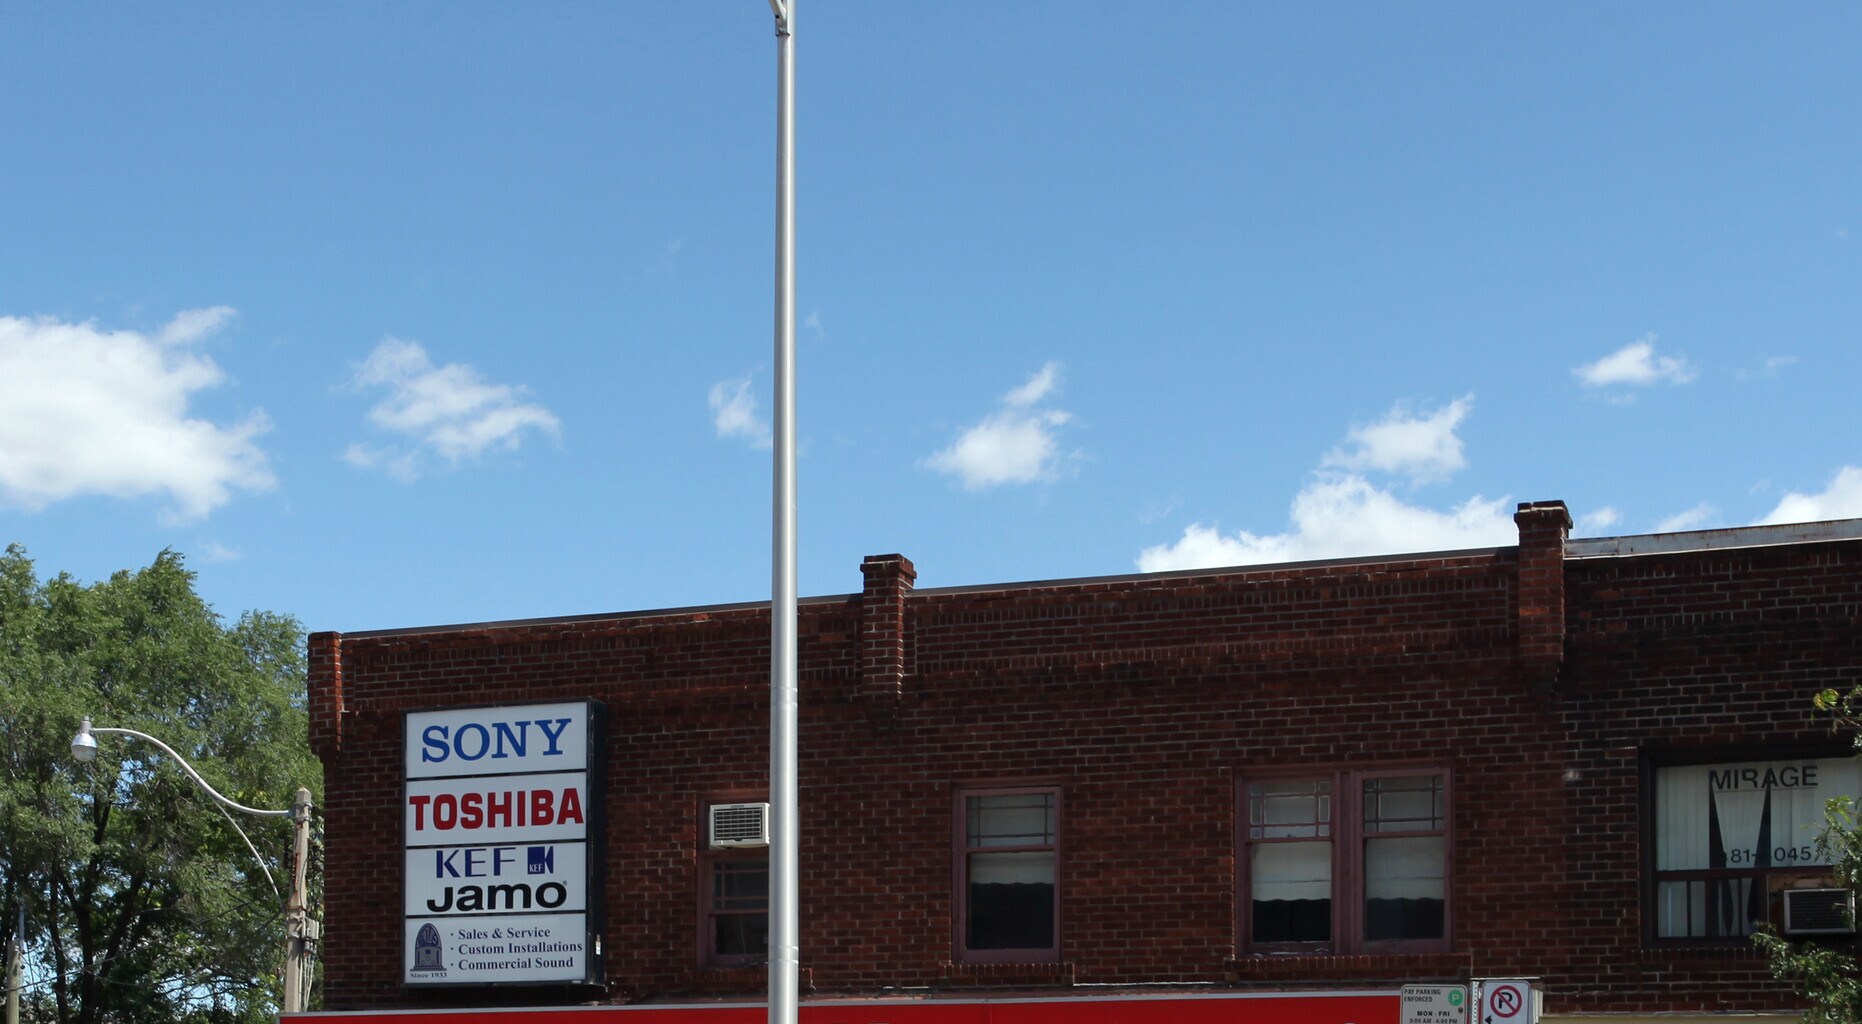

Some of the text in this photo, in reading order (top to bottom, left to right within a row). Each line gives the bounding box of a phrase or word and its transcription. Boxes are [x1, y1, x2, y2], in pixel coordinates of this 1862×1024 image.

[422, 718, 572, 763] SONY
[1709, 765, 1818, 790] MIRAGE
[409, 788, 584, 831] TOSHIBA
[436, 847, 516, 878] KEF
[529, 864, 543, 873] KEF
[458, 927, 551, 940] Sales & Service
[459, 941, 583, 955] Custom Installations
[459, 957, 573, 970] Commercial Sound
